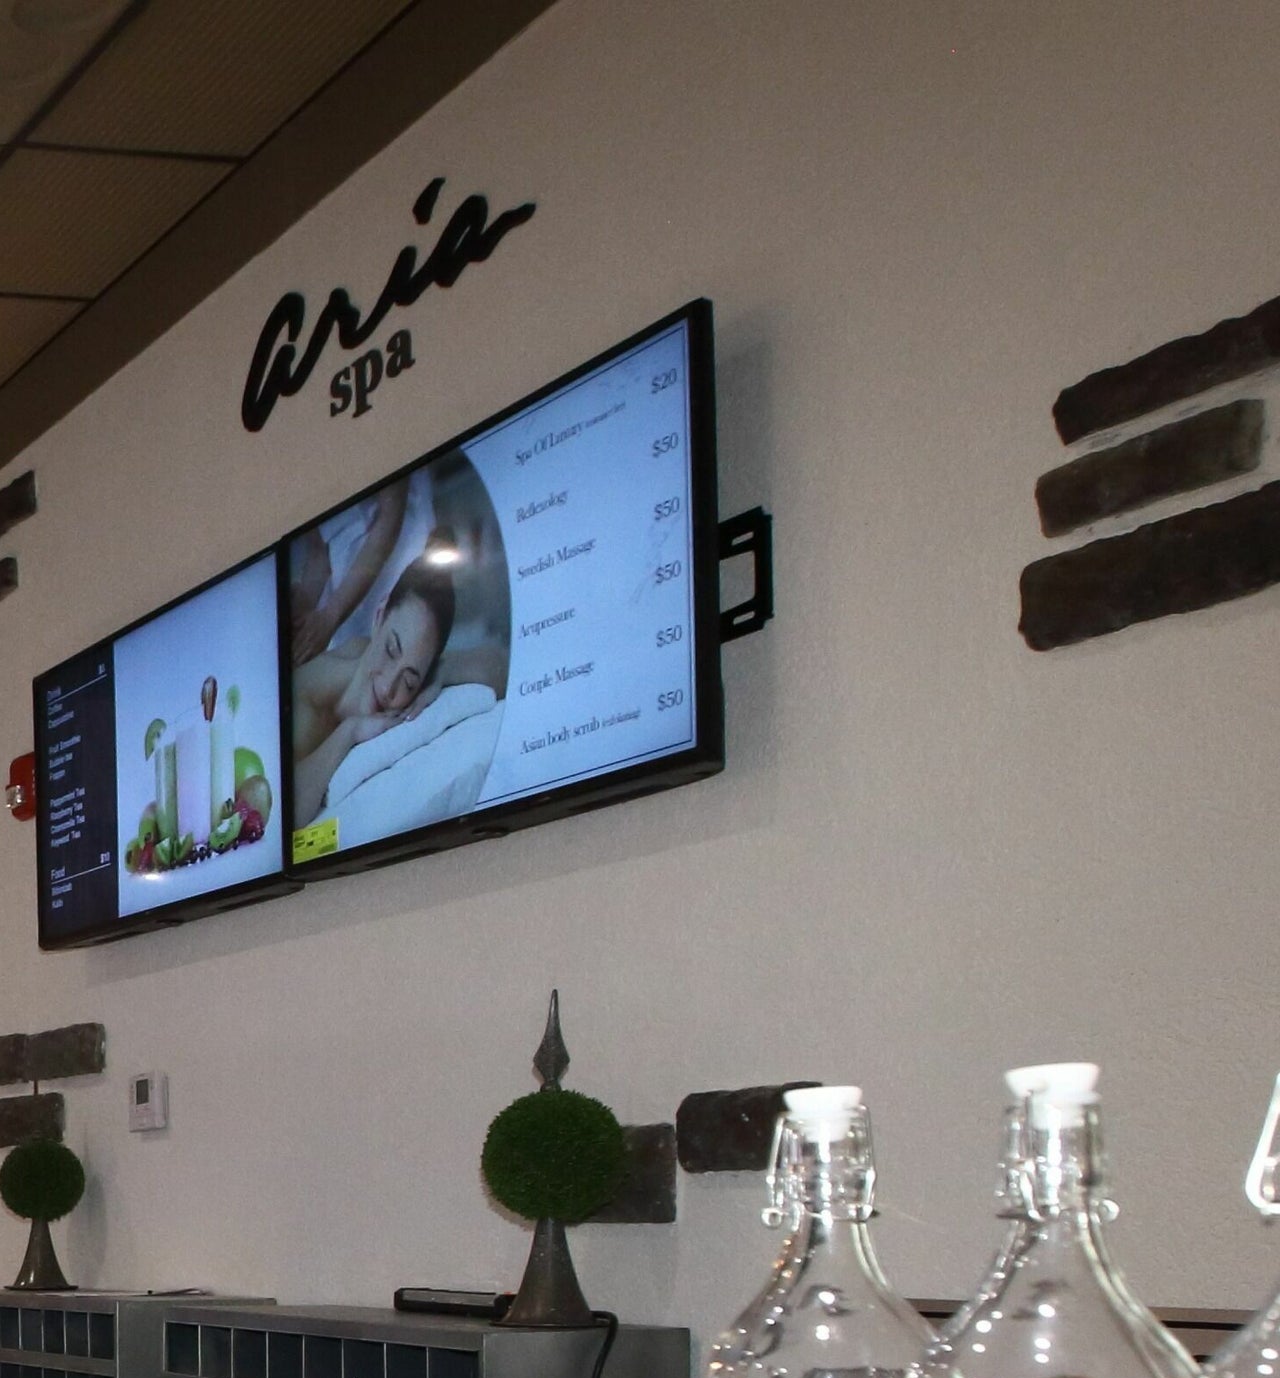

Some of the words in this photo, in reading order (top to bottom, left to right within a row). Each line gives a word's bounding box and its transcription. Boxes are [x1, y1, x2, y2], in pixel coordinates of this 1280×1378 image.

[330, 328, 415, 418] spa
[651, 368, 678, 394] $20
[515, 449, 532, 466] Spa
[550, 423, 582, 448] Luxury
[652, 432, 679, 458] $50
[515, 489, 569, 523] Reflexology
[654, 496, 680, 521] $50
[517, 554, 555, 581] Swedish
[556, 538, 597, 565] Massage
[655, 560, 682, 584] $50
[519, 607, 576, 639] Acupressure
[656, 625, 683, 648] $50
[519, 674, 553, 697] Couple
[554, 661, 595, 683] Massage
[658, 689, 684, 712] $50
[520, 739, 546, 755] Asian
[547, 727, 570, 745] body
[573, 717, 600, 736] scrub
